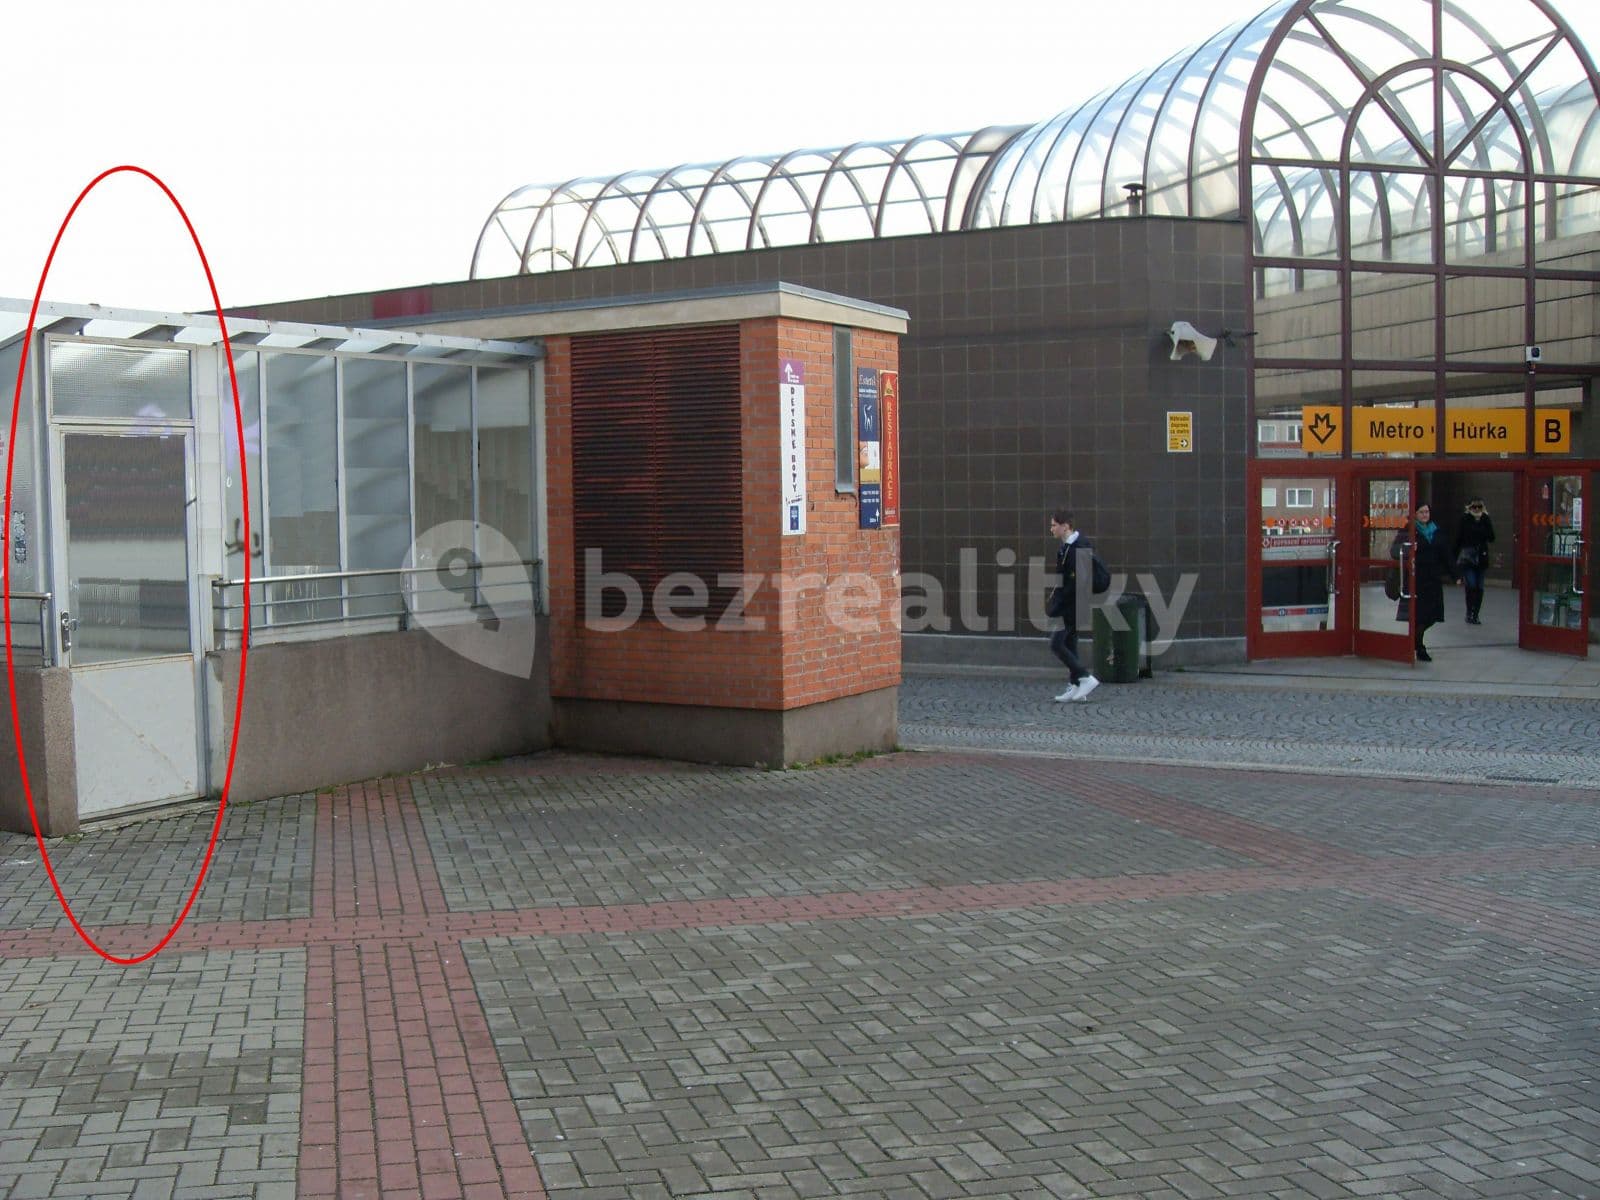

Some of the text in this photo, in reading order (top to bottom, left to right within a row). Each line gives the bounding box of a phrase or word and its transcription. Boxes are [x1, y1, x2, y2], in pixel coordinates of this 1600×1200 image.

[1370, 421, 1507, 439] Metro Hůrka
[1544, 419, 1562, 443] B
[886, 402, 894, 500] RESTAURACE
